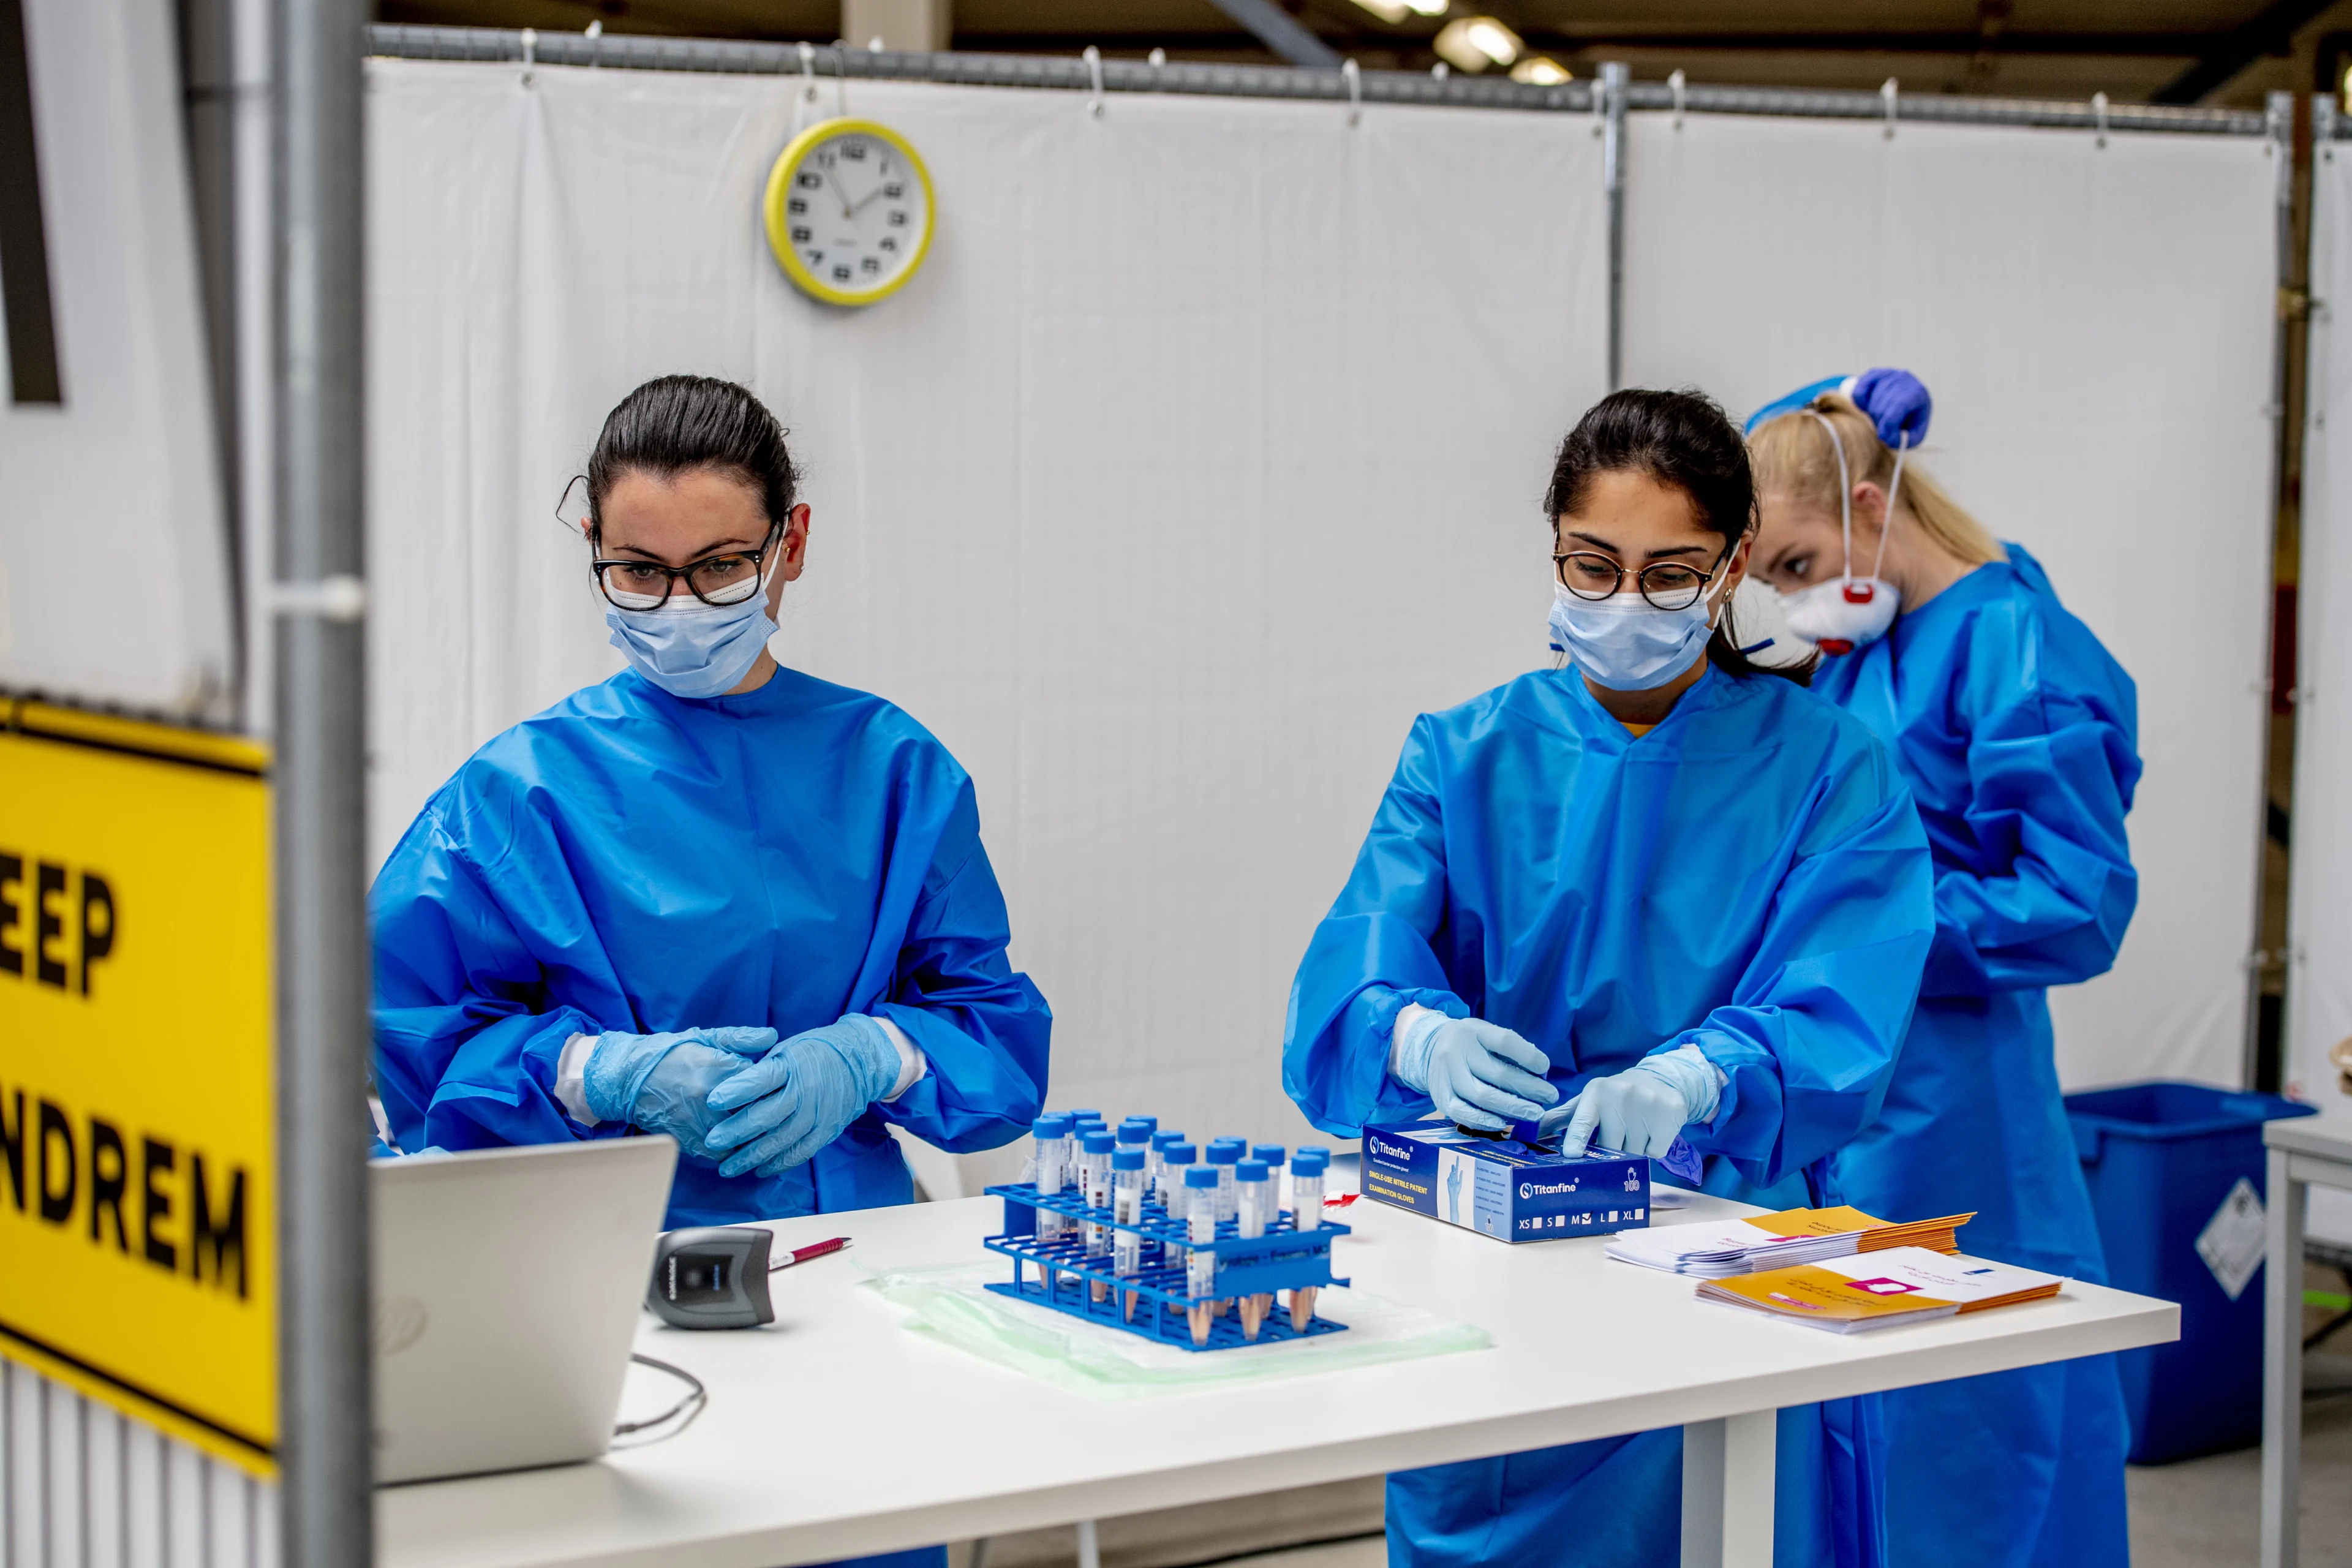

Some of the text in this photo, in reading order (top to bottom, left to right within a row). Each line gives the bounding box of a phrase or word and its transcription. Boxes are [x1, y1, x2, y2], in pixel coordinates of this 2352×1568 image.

[1369, 1170, 1427, 1194] SINGLE-USE NITRILE PATIENT
[1624, 1180, 1640, 1191] 100
[1369, 1184, 1414, 1204] EXAMINATION GLOVES
[1519, 1211, 1634, 1229] XS S M L XL
